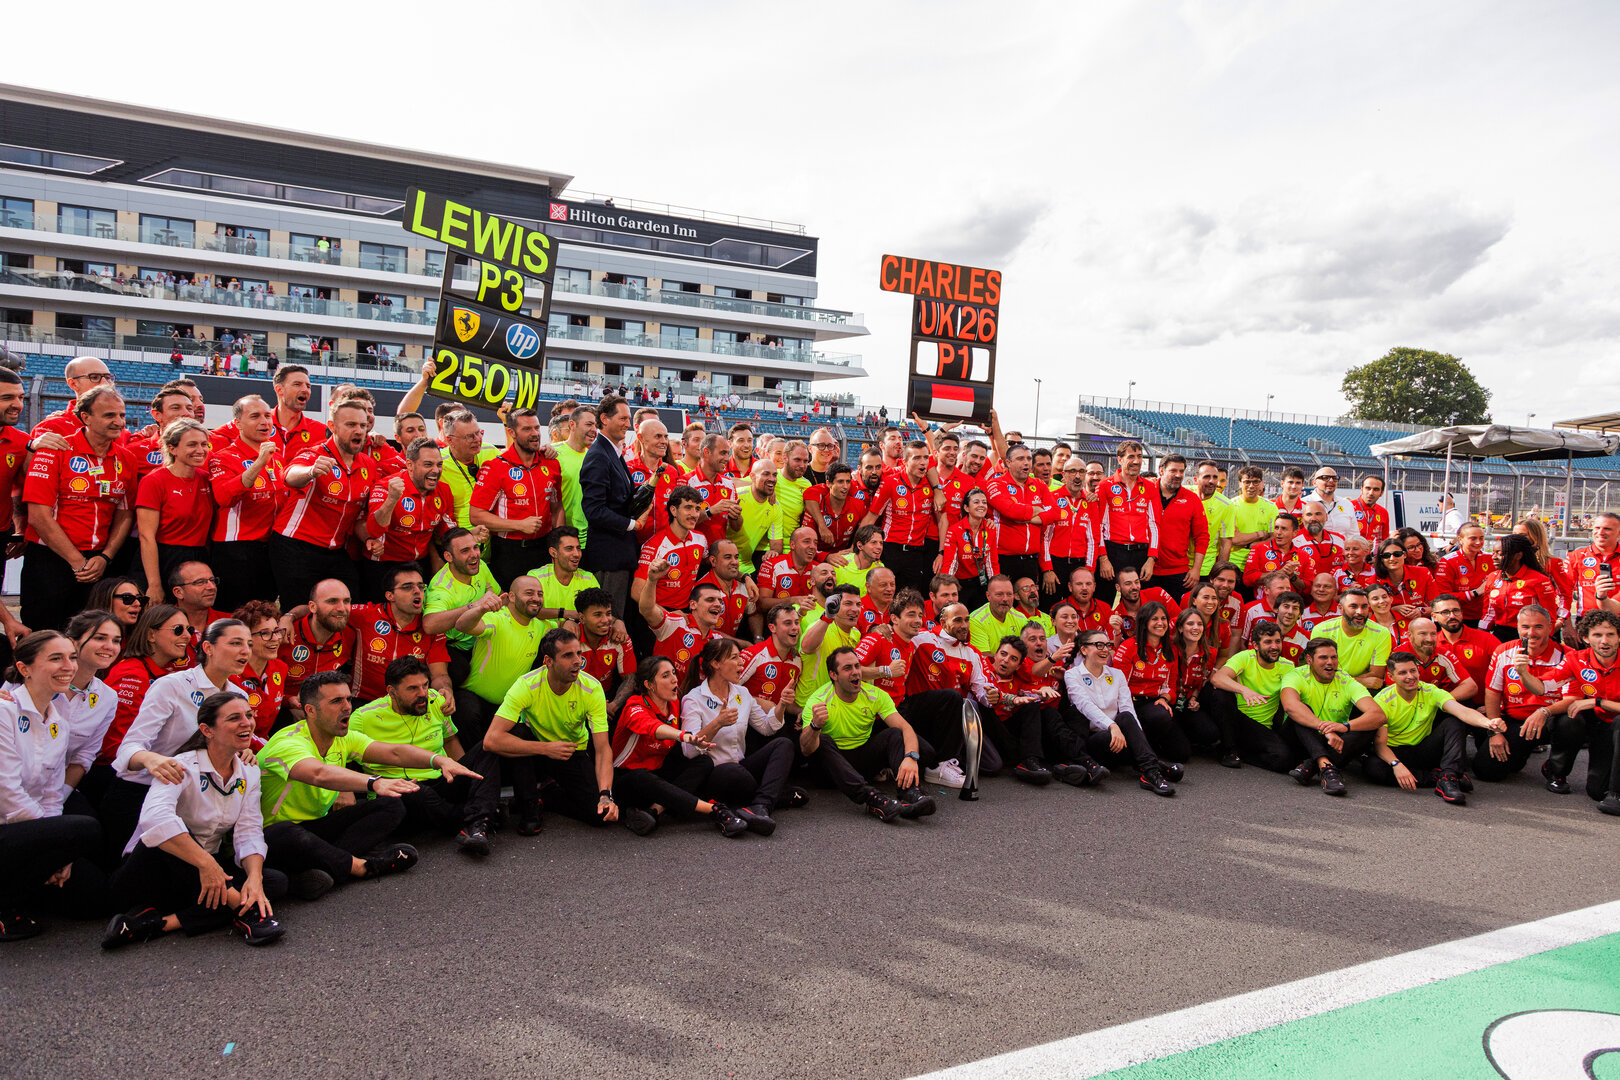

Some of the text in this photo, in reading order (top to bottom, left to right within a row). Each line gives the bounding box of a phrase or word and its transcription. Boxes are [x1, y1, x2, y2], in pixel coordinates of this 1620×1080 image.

[570, 208, 697, 238] Hilton Garden Inn
[411, 189, 550, 274] LEWIS
[477, 261, 524, 311] P3
[881, 255, 1001, 306] CHARLES
[508, 323, 537, 359] hp
[937, 342, 969, 378] P1
[72, 457, 87, 472] hp
[511, 468, 522, 480] hp
[634, 471, 643, 483] hp
[1113, 486, 1120, 494] hp
[404, 498, 414, 511] hp
[1059, 498, 1067, 507] hp
[669, 553, 678, 566] hp
[1584, 558, 1595, 566] hp
[782, 577, 791, 588] hp
[865, 612, 874, 622] hp
[377, 621, 390, 634] hp
[1304, 621, 1313, 630] hp
[685, 633, 693, 647] hp
[295, 646, 308, 661] hp
[368, 653, 385, 664] IBM
[934, 650, 943, 662] hp
[767, 665, 776, 678] hp
[1583, 669, 1595, 681] hp
[881, 678, 894, 687] IBM
[118, 689, 134, 698] ZCG
[193, 692, 203, 706] hp
[20, 716, 29, 732] hp
